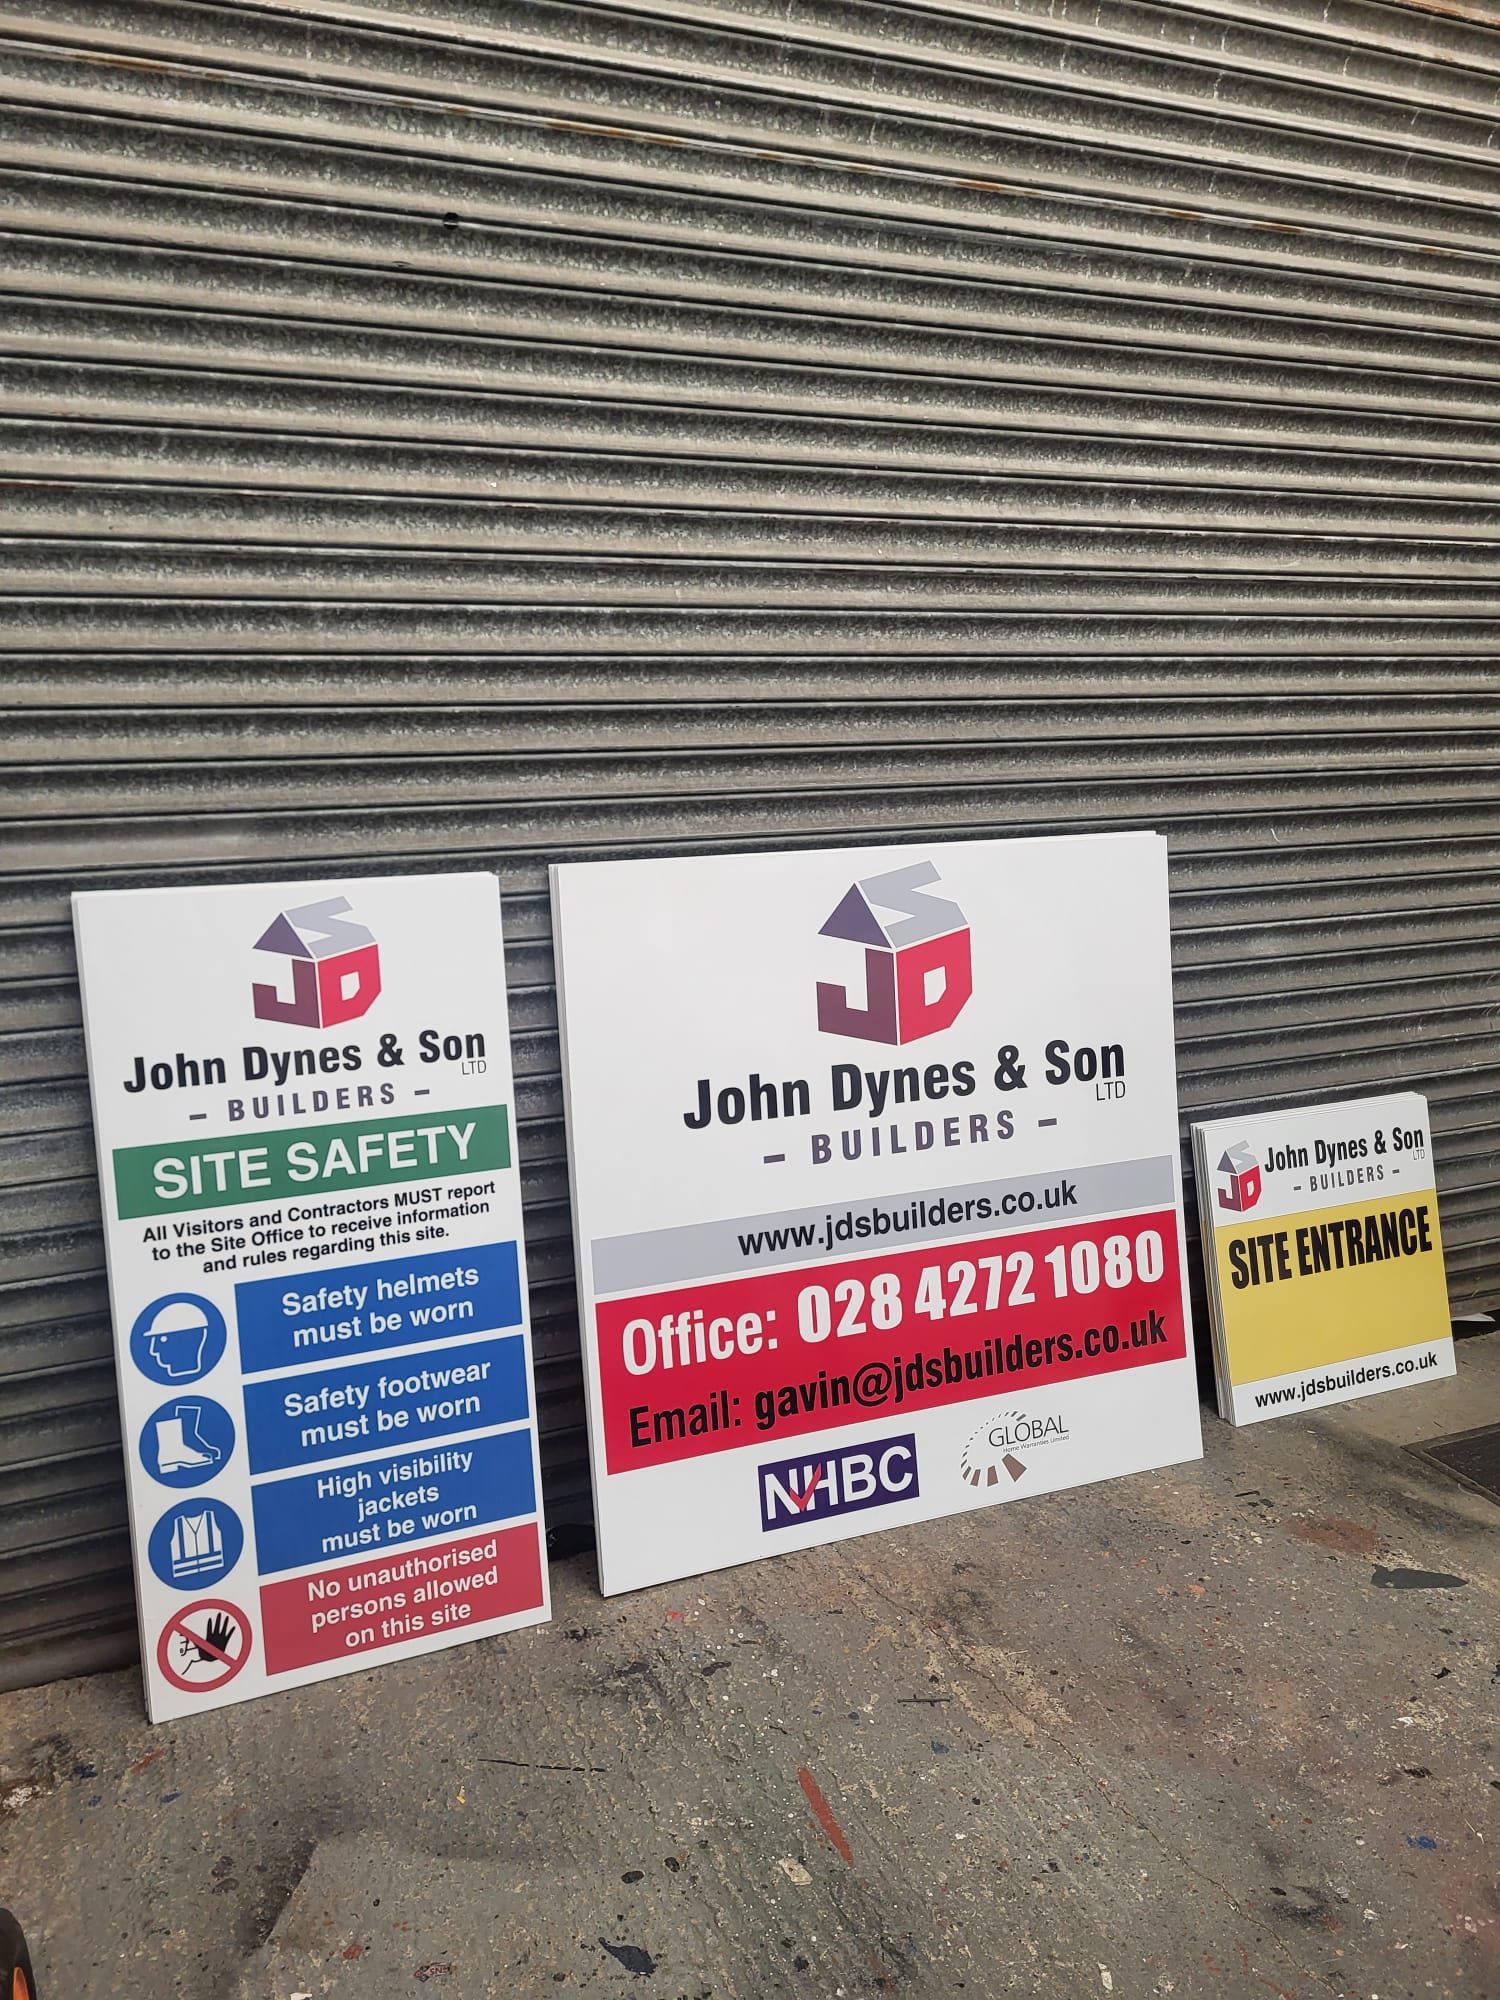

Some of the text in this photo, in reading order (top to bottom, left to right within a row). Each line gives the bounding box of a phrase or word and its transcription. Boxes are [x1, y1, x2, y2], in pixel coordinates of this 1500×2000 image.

[124, 1029, 485, 1093] John Dynes & Son
[462, 1060, 487, 1076] LTD
[683, 1040, 1126, 1130] John Dynes & Son
[228, 1082, 395, 1122] BUILDERS
[1096, 1080, 1127, 1103] LTD
[153, 1122, 476, 1199] SITE SAFETY
[811, 1110, 1015, 1165] BUILDERS
[1264, 1127, 1424, 1173] John Dynes & Son
[1413, 1149, 1425, 1161] LTD
[1310, 1165, 1384, 1193] BUILDERS
[143, 1181, 496, 1243] All Visitors and Contractors MUST report
[152, 1200, 490, 1261] to the Site Office to receive information
[737, 1180, 1078, 1257] www.jdsbuilders.co.uk
[202, 1224, 450, 1274] and rules regarding this site.
[1229, 1205, 1433, 1290] SITE ENTRANCE
[282, 1265, 480, 1317] Safety helmets
[622, 1230, 1164, 1376] Office: 028 4272 1080
[293, 1300, 474, 1348] must be worn
[284, 1360, 492, 1418] Safety footwear
[629, 1310, 1168, 1448] Email: gavin@jdsbuilders.co.uk
[1255, 1351, 1438, 1408] www.jdsbuilders.co.uk
[301, 1395, 481, 1448] must be worn
[988, 1415, 1069, 1447] GLOBAL
[1003, 1444, 1020, 1453] Home
[1050, 1434, 1070, 1443] Limited
[316, 1450, 474, 1500] High visibility
[764, 1443, 914, 1521] NHBC
[322, 1504, 478, 1554] must be worn
[356, 1485, 440, 1523] jackets
[307, 1540, 498, 1602] No unauthorised
[311, 1567, 499, 1633] persons allowed
[345, 1602, 472, 1648] on this site
